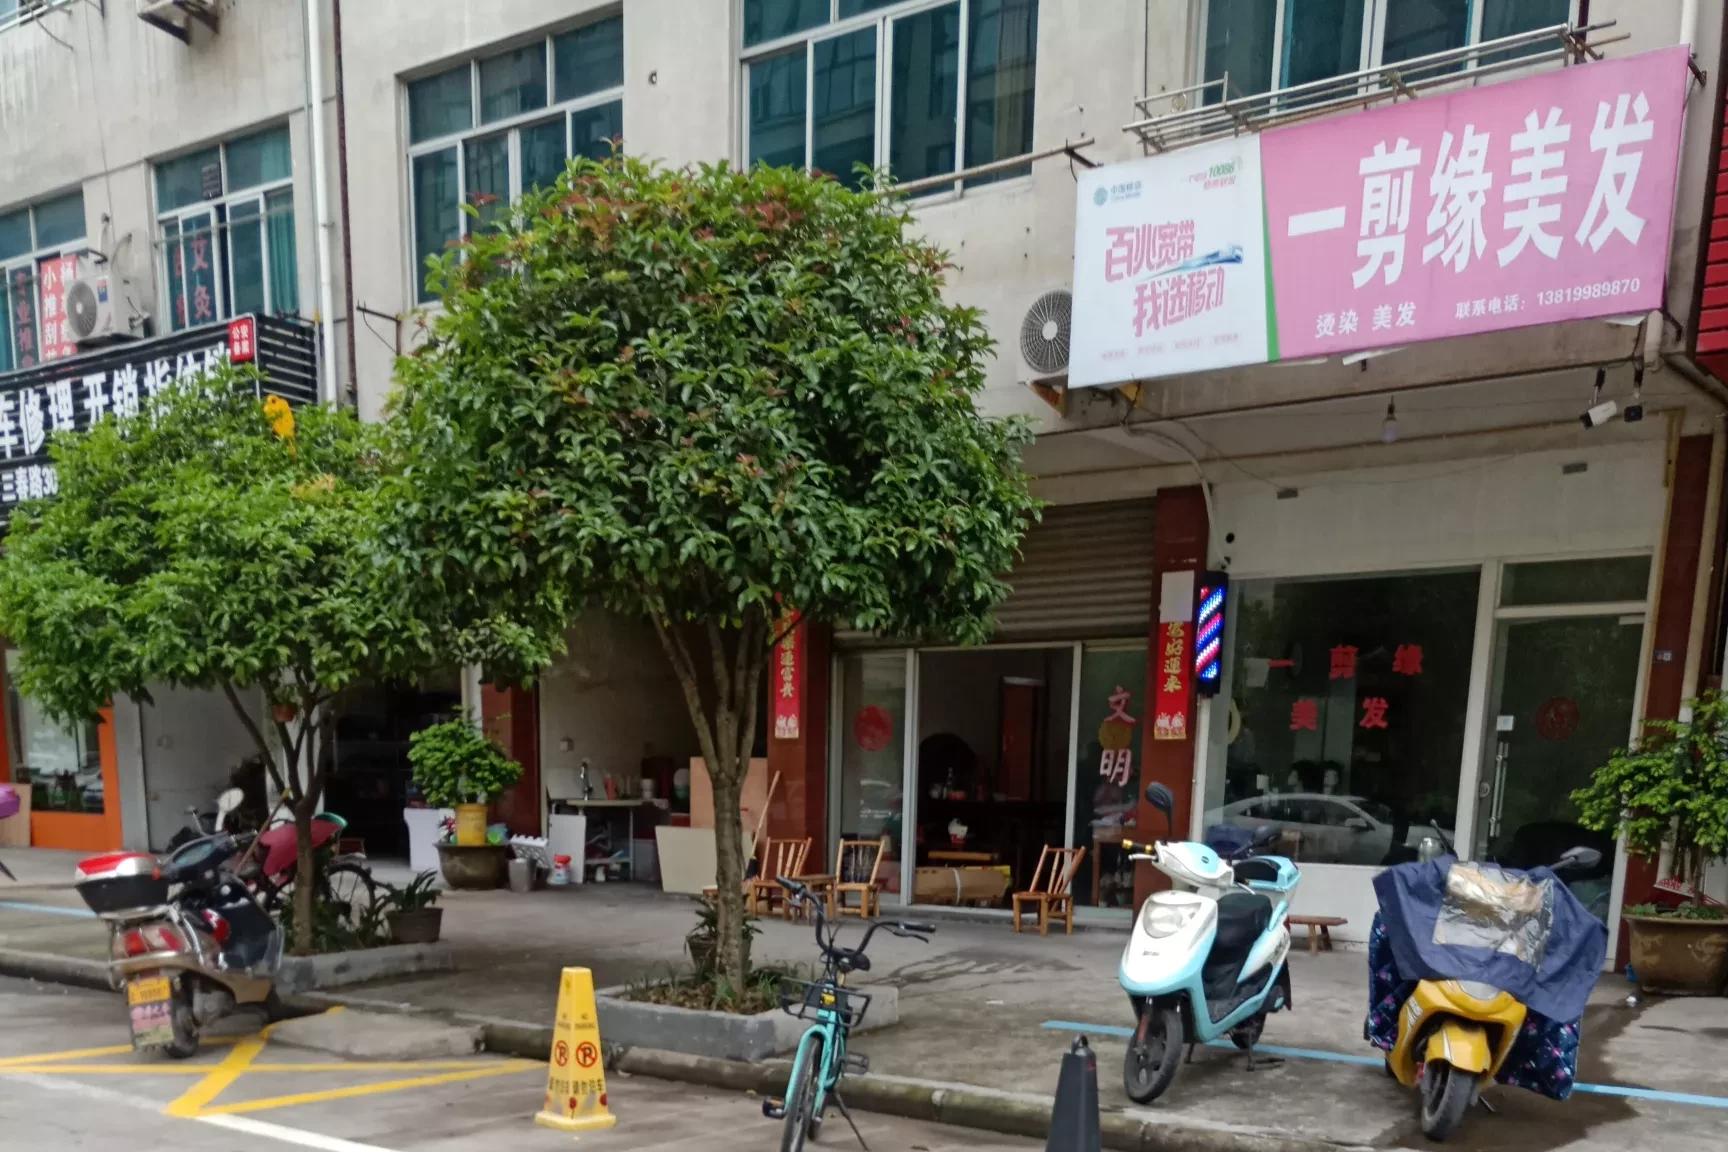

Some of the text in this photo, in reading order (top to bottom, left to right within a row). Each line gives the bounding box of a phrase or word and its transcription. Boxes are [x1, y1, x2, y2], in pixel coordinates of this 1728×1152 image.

[1287, 90, 1655, 290] 一剪缘美发
[1132, 266, 1225, 338] 我选移动
[1535, 277, 1641, 307] 13819989870
[1314, 301, 1417, 339] 烫染 美发
